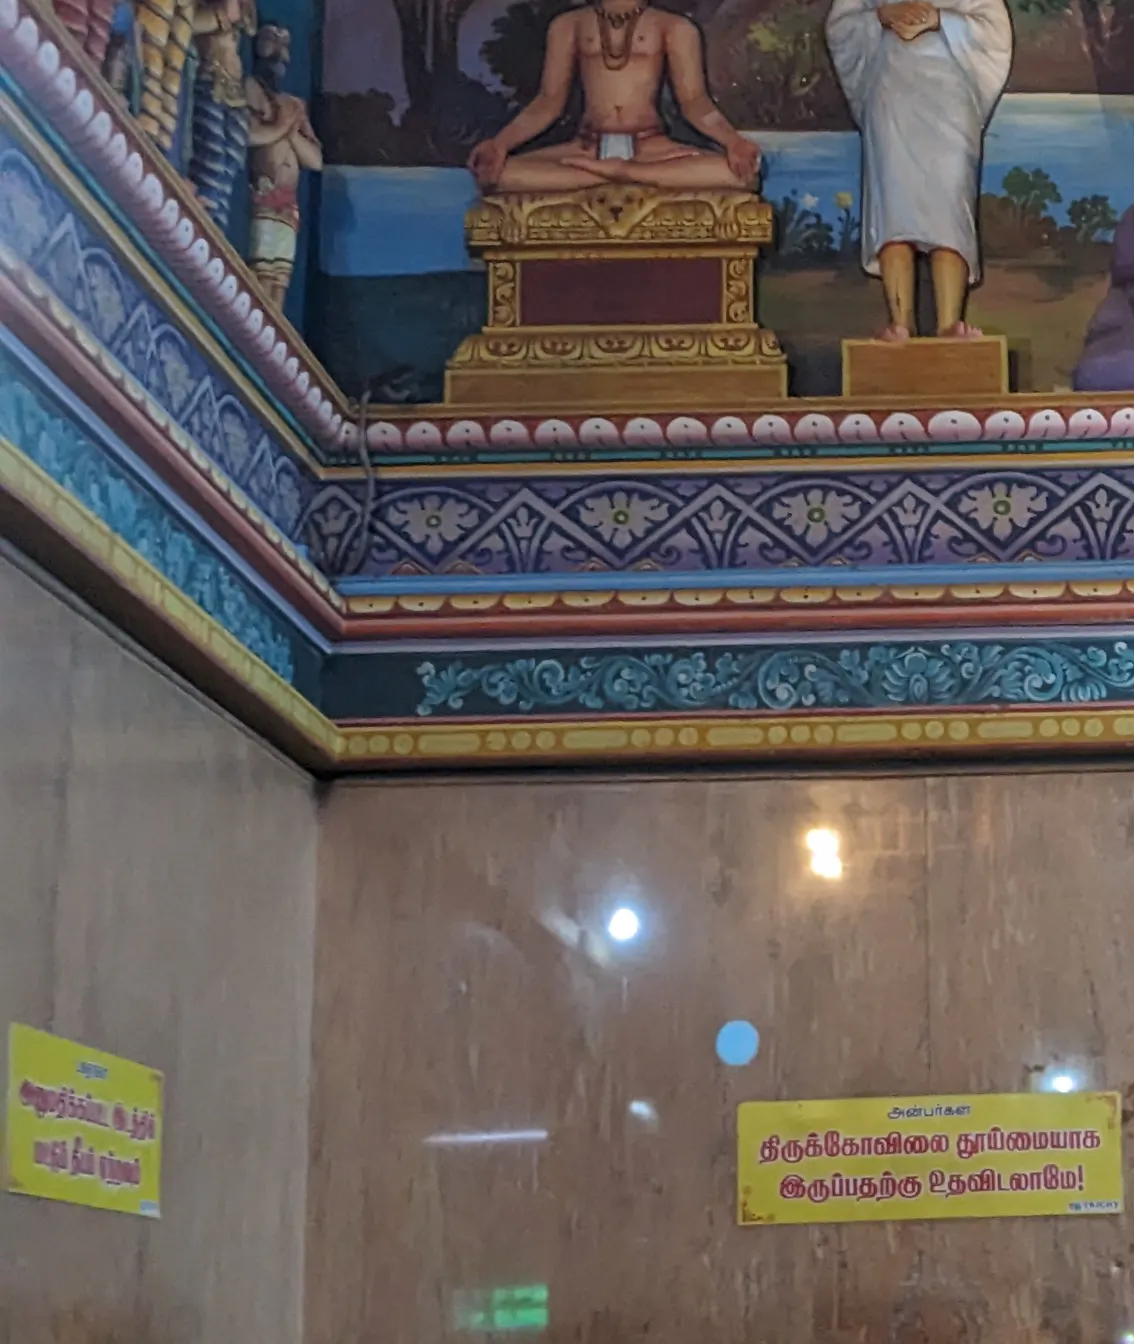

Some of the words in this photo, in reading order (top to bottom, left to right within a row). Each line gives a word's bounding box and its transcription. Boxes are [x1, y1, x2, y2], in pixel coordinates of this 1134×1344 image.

[758, 1130, 950, 1164] திருக்கோவிலை
[956, 1126, 1101, 1159] தூய்மையாக
[779, 1171, 922, 1203] இருப்பதற்கு
[929, 1164, 1084, 1197] உதவிடலாமே!
